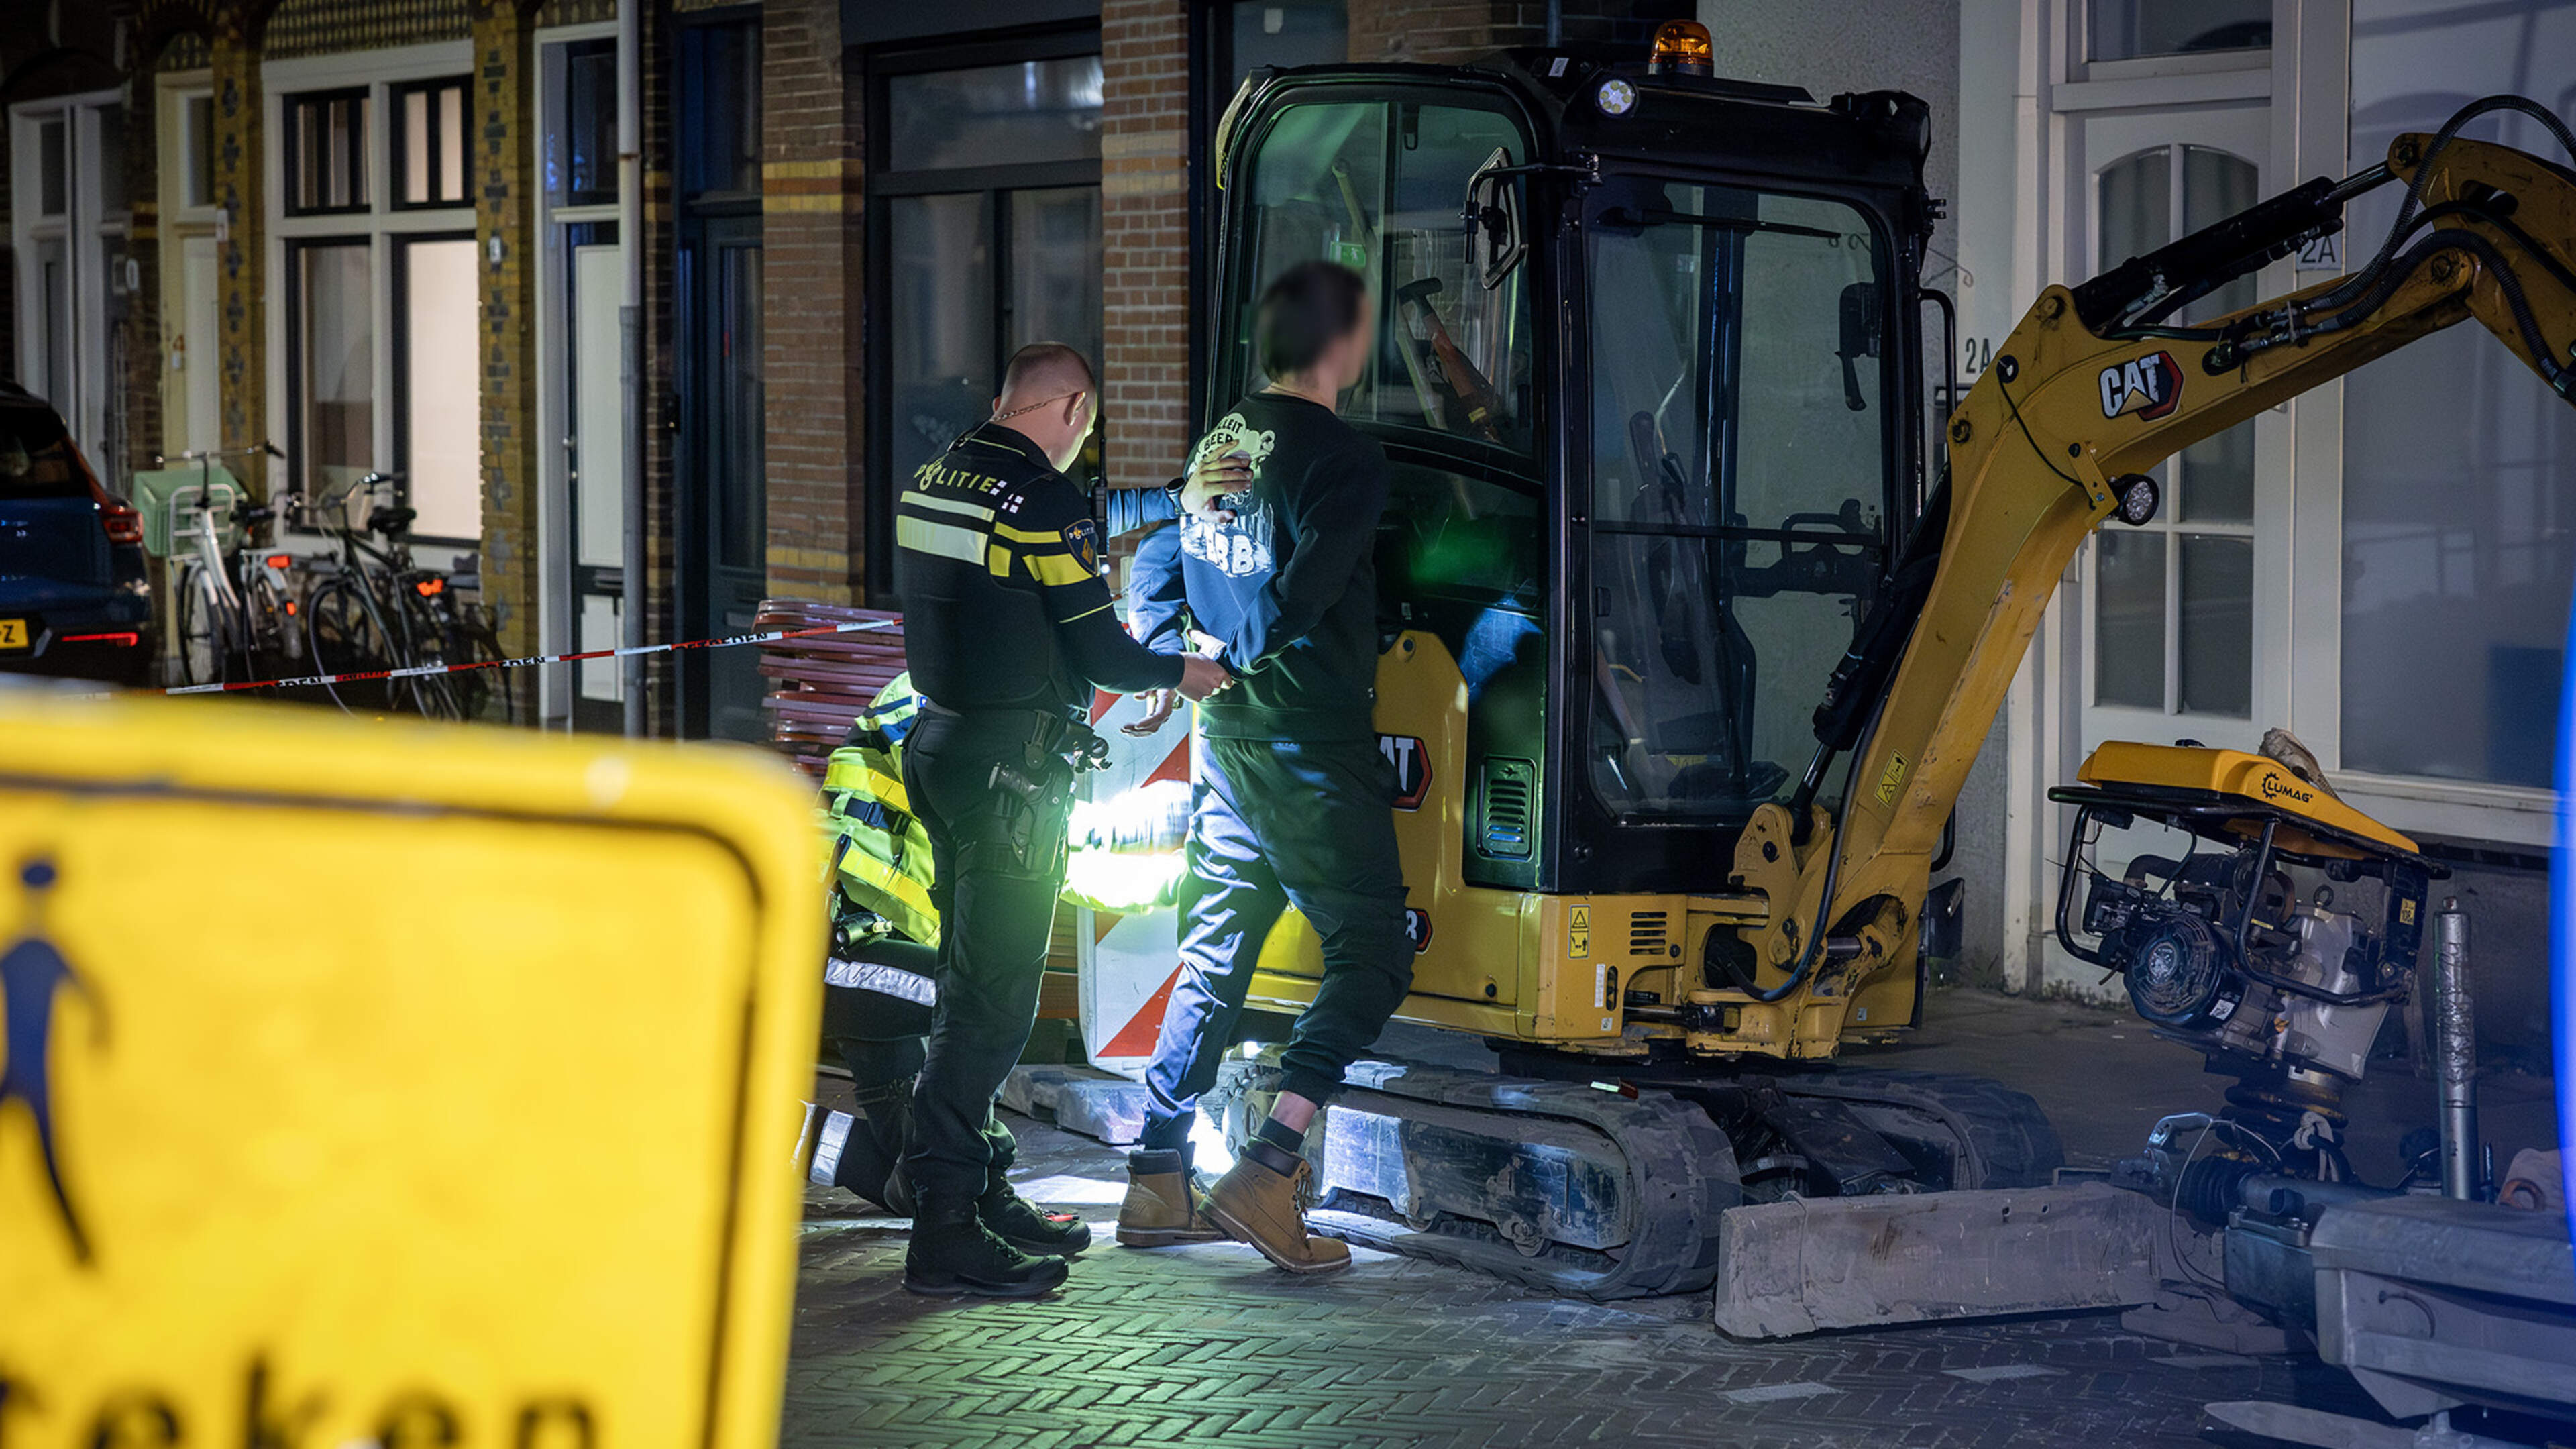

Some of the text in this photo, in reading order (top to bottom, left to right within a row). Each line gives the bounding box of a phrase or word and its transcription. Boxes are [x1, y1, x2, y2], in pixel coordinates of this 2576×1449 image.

[2301, 235, 2336, 263] 2A
[1966, 337, 1990, 374] 2A
[2100, 354, 2160, 417] CAT
[914, 459, 997, 491] POLITIE
[1379, 736, 1415, 792] AT
[2267, 780, 2310, 802] LUMAG
